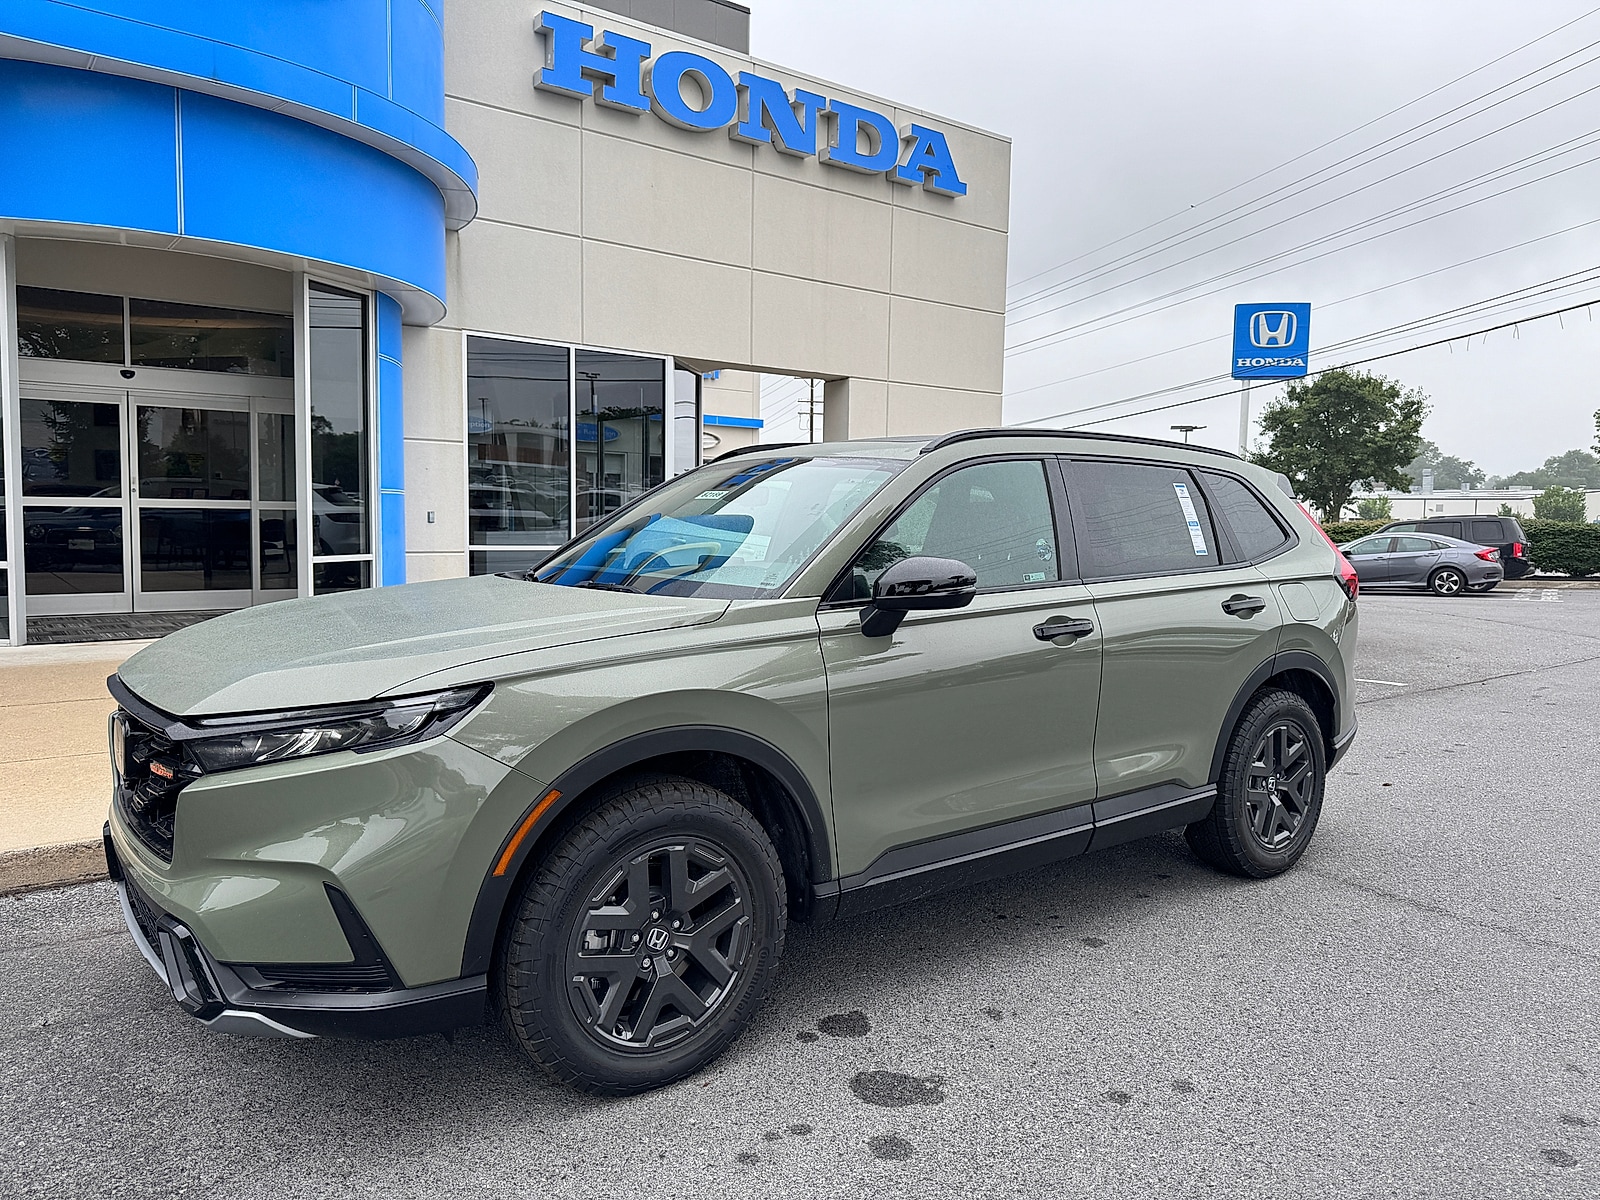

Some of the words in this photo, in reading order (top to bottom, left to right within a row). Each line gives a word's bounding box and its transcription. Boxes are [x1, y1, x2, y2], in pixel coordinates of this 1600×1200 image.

[534, 10, 968, 198] HONDA
[1236, 358, 1306, 367] HONDA
[734, 946, 770, 1016] Continental
